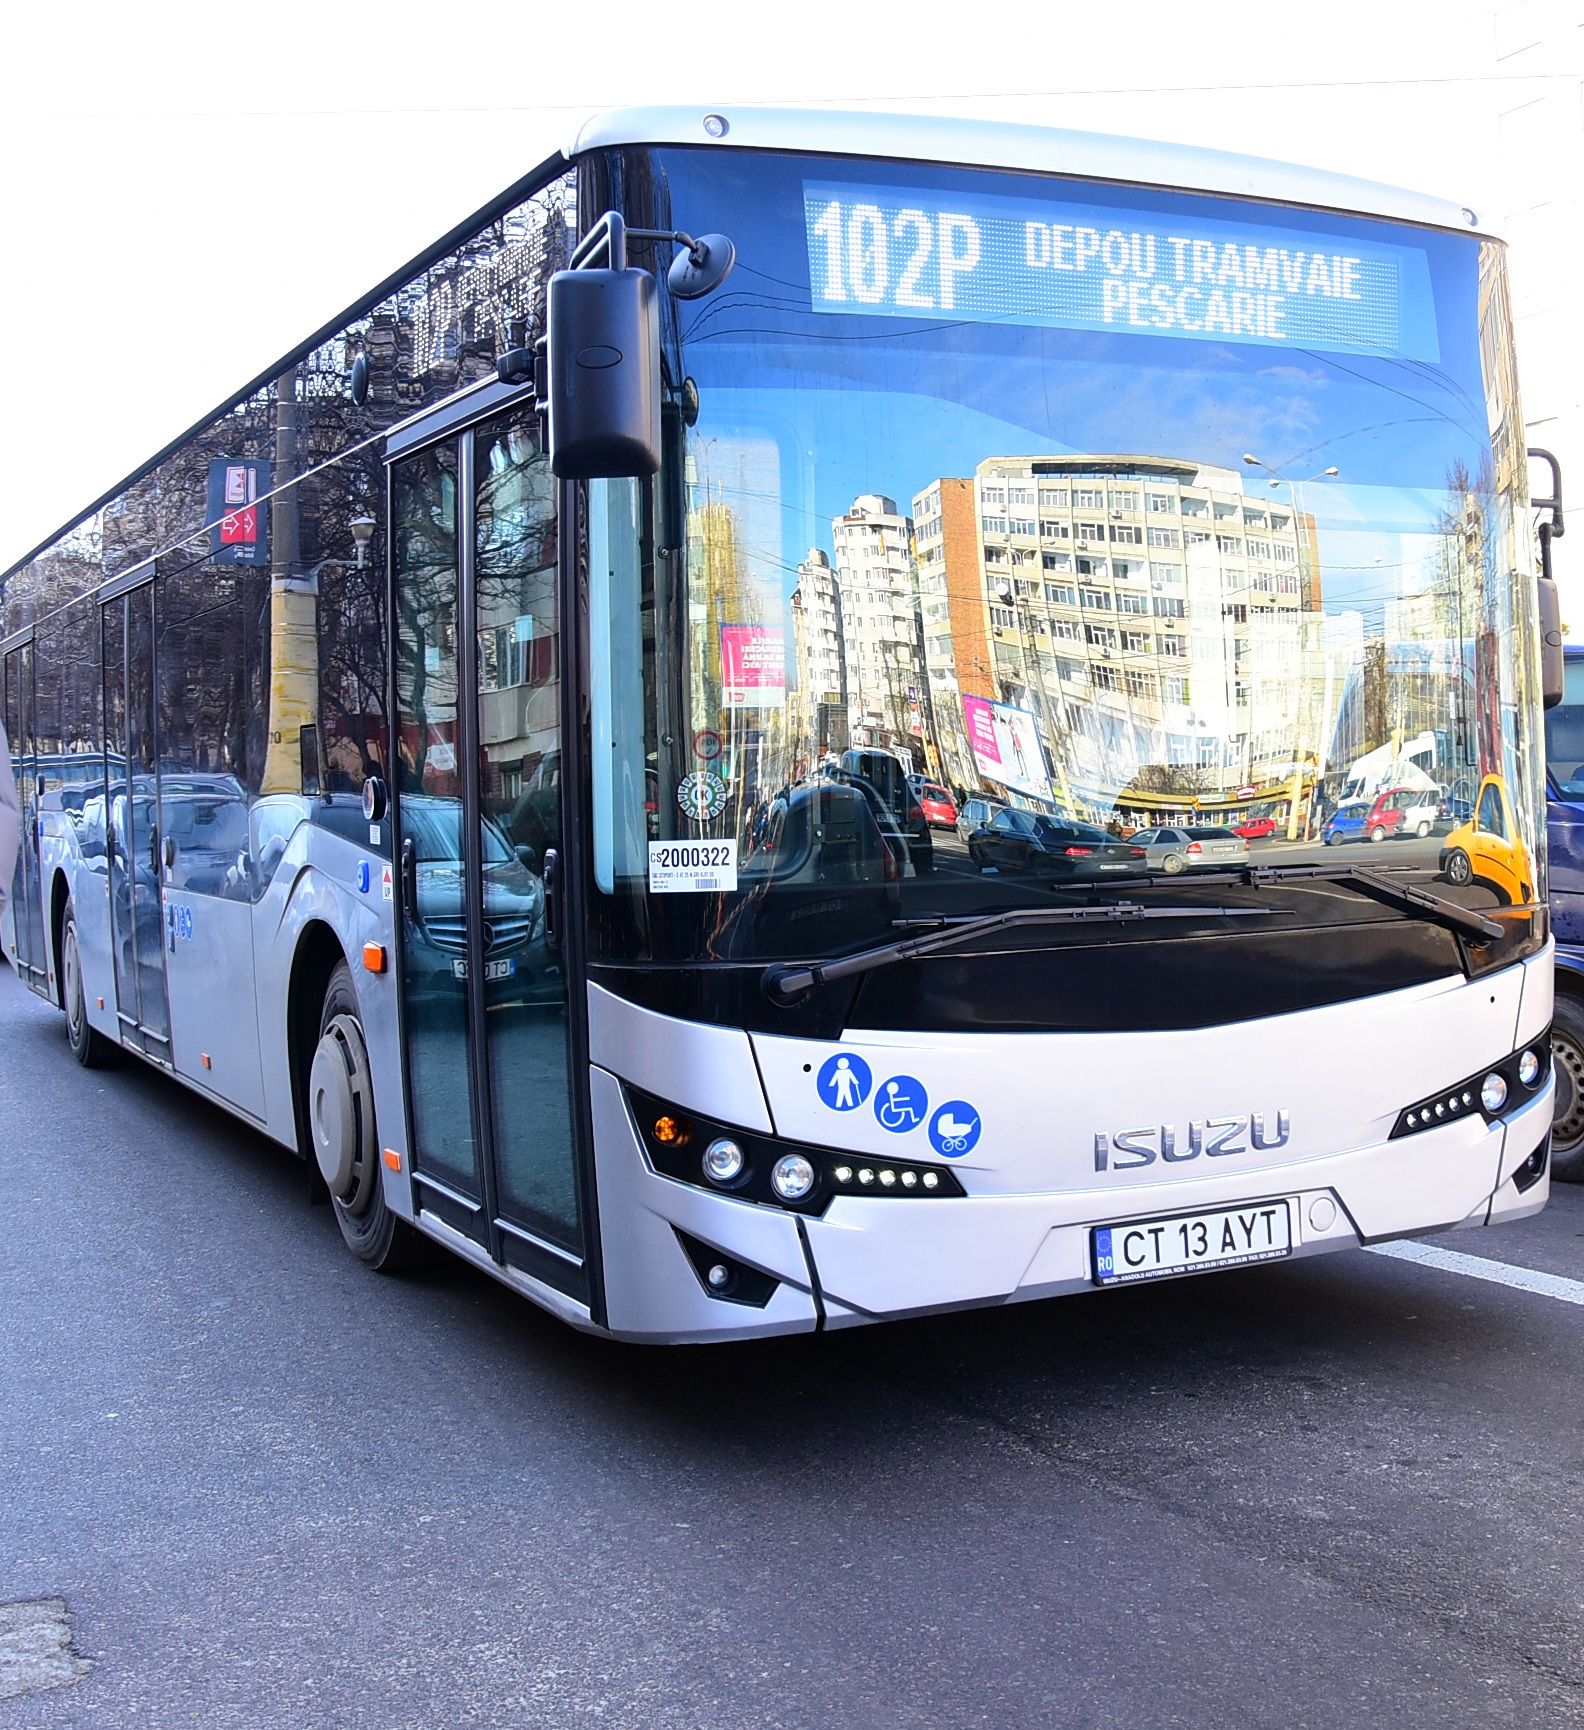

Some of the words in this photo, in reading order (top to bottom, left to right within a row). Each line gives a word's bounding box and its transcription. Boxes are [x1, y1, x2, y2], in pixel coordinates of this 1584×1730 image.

[814, 201, 980, 309] 102P
[1026, 221, 1154, 277] DEPOU
[1167, 237, 1361, 299] TRAMVAIE
[1102, 279, 1287, 338] PESCARIE
[1094, 1108, 1290, 1172] ISUZU
[1097, 1256, 1112, 1272] RO
[1123, 1227, 1165, 1267] CT
[1179, 1221, 1208, 1259] 13
[1221, 1209, 1276, 1253] AYT
